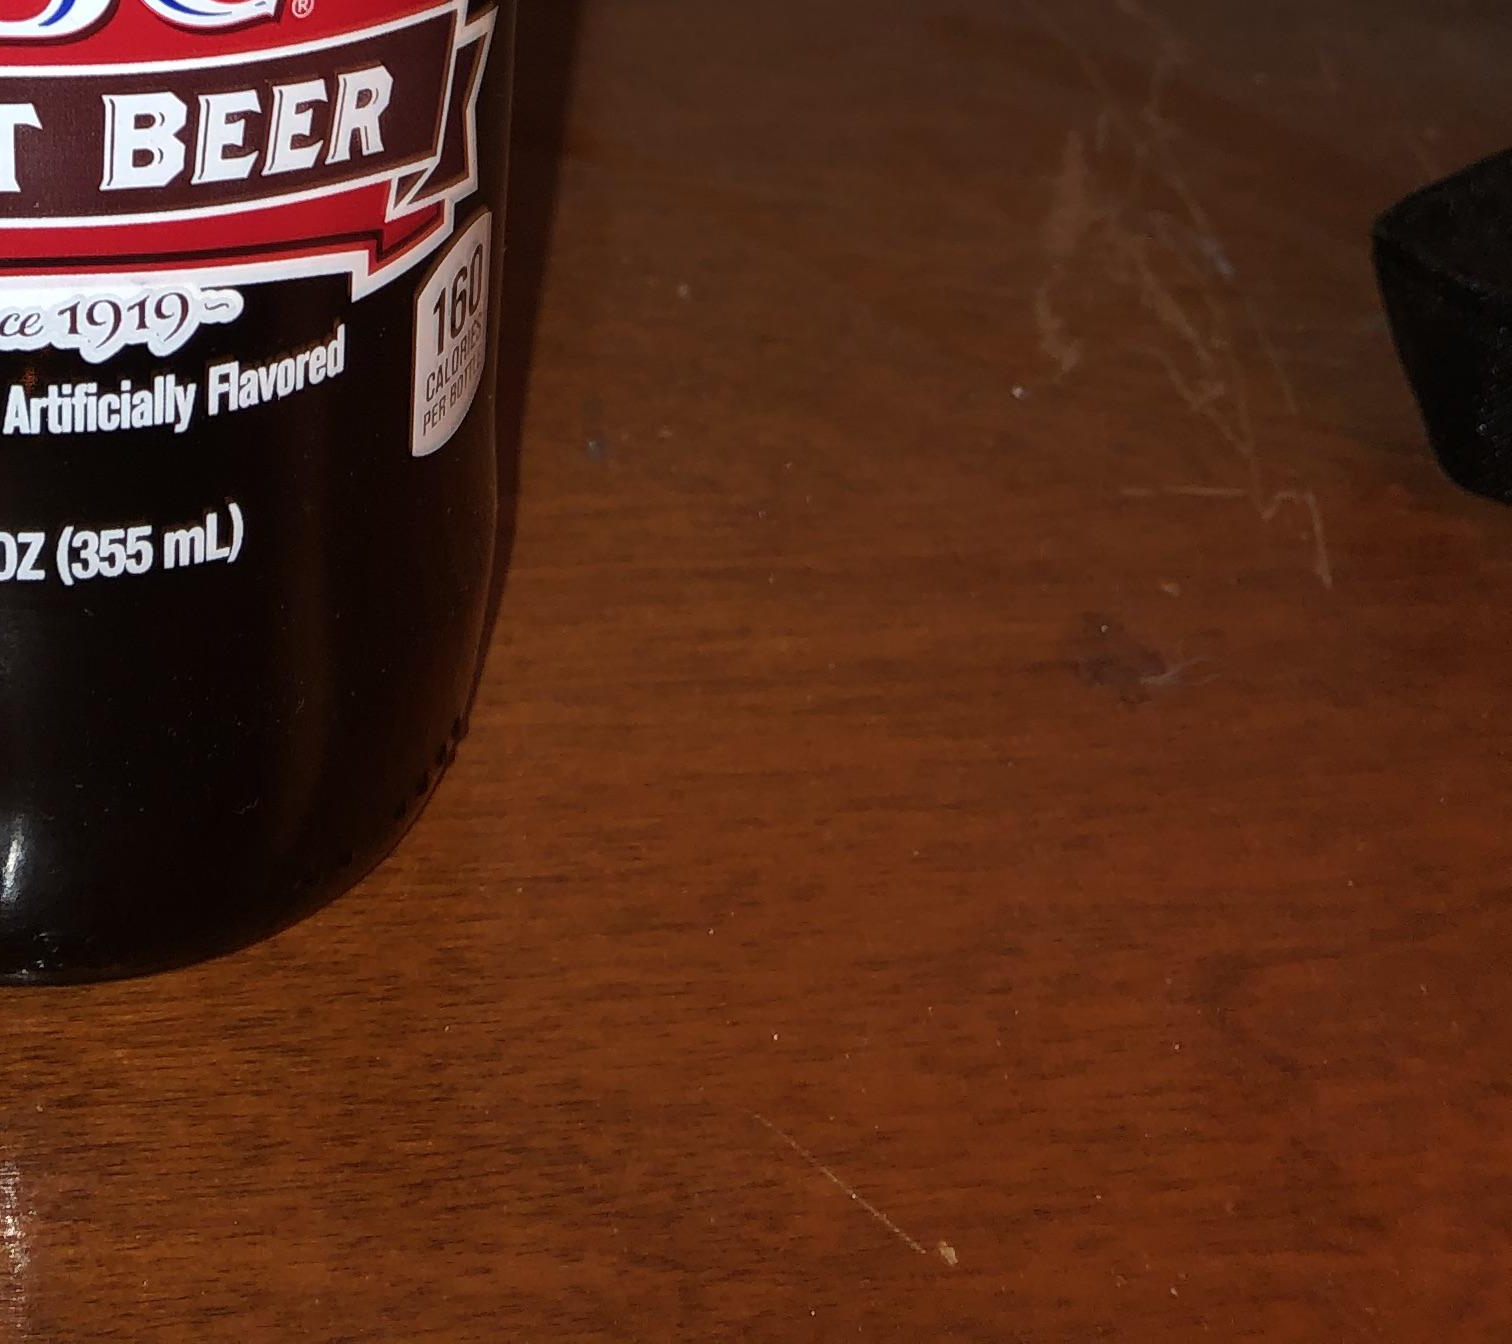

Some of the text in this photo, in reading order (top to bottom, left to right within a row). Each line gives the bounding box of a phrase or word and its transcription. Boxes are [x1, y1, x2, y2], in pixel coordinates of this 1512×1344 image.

[99, 63, 395, 192] BEER
[57, 291, 189, 350] 1919
[433, 242, 484, 356] 160
[2, 373, 197, 435] Artificially
[207, 323, 346, 416] Flavored
[425, 314, 483, 403] CALORIES
[422, 395, 447, 437] PER
[56, 525, 154, 586] (355
[163, 502, 244, 569] mL)
